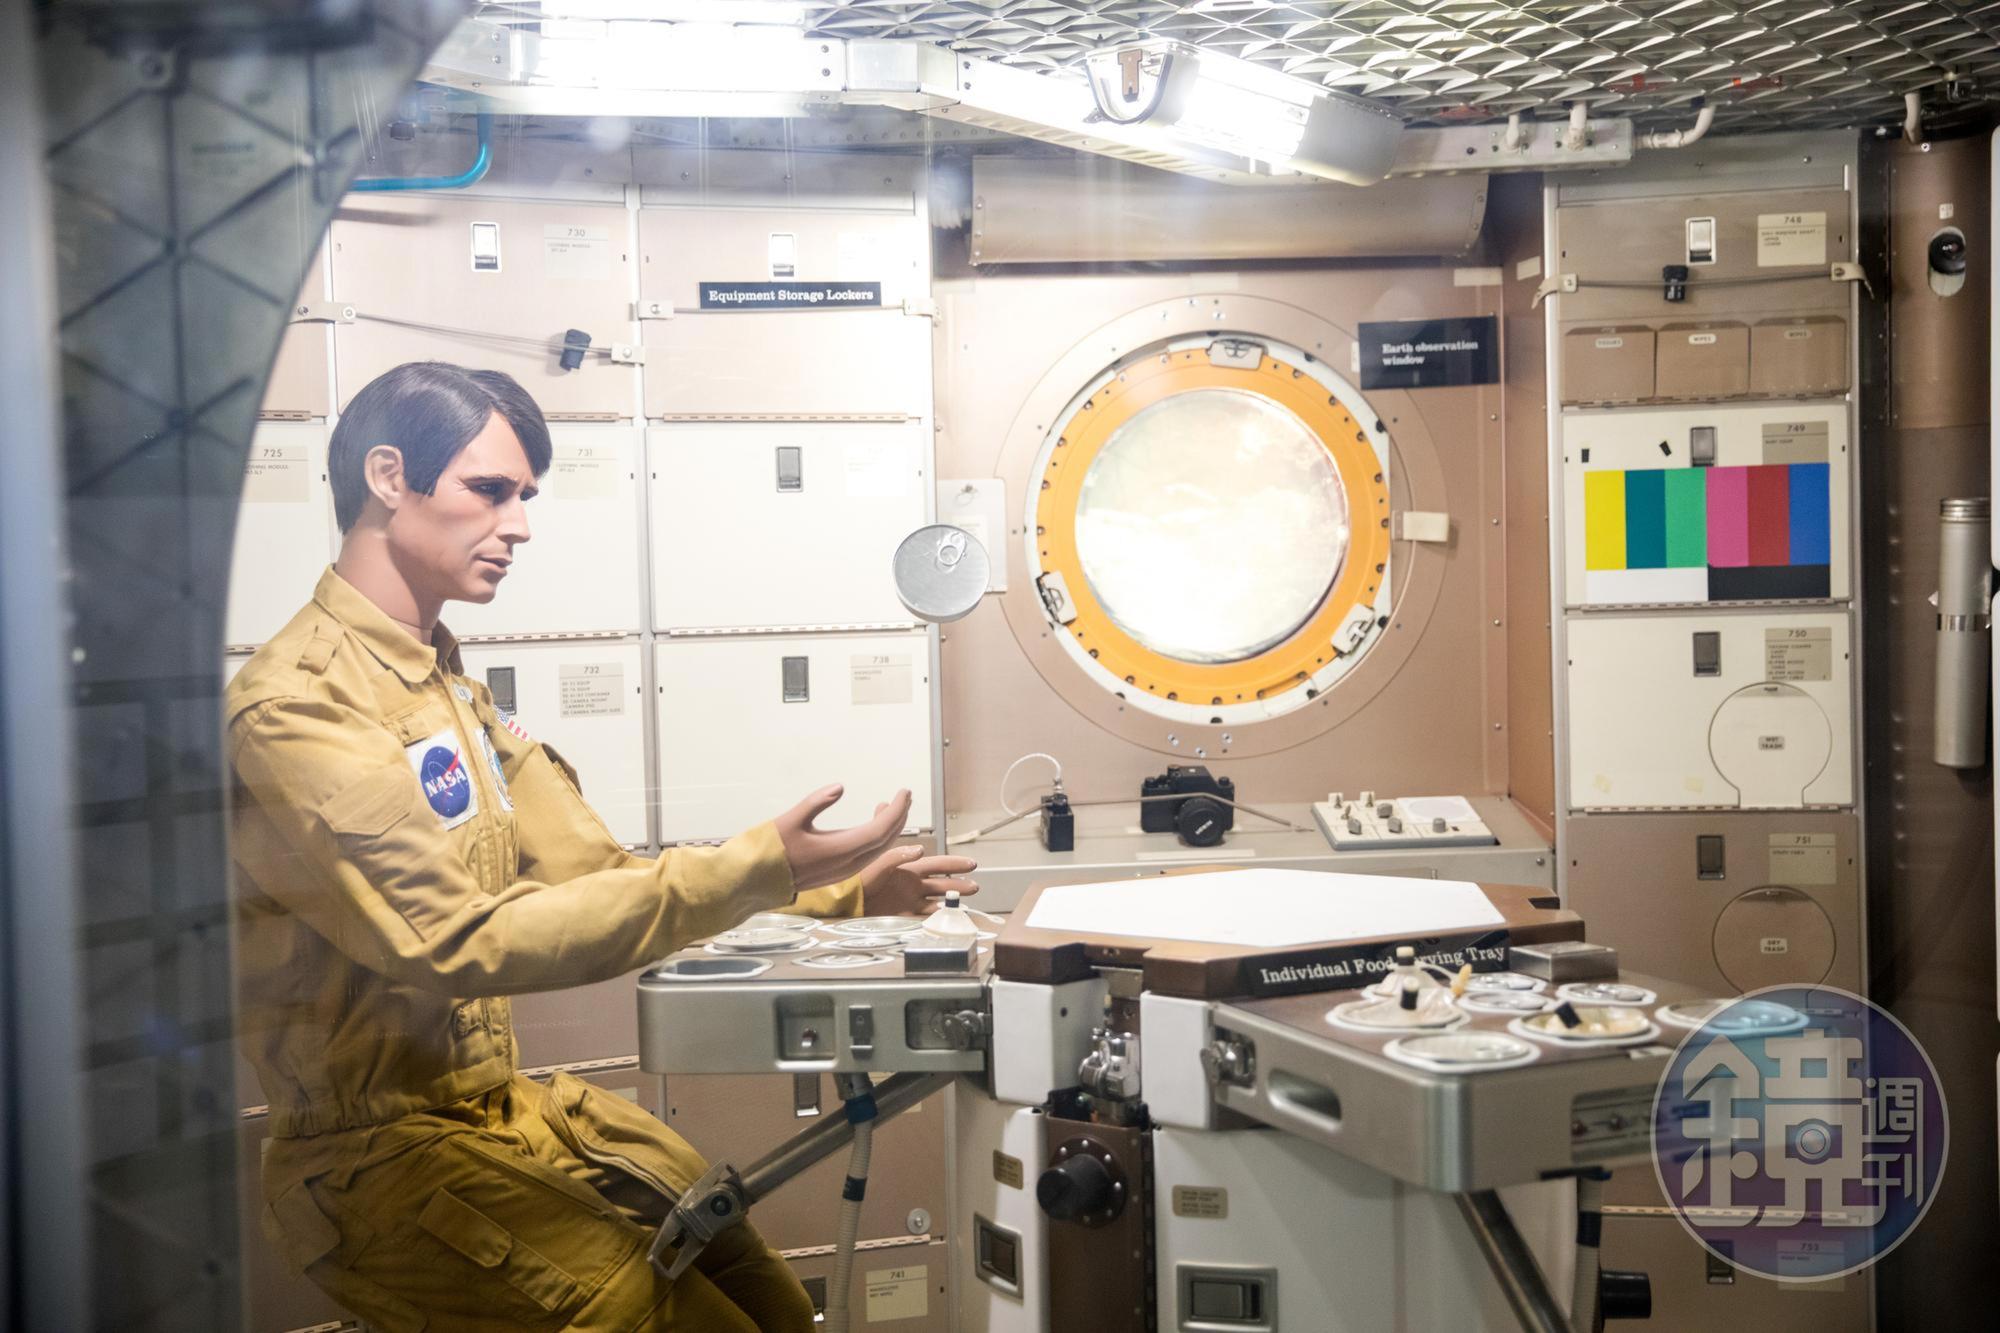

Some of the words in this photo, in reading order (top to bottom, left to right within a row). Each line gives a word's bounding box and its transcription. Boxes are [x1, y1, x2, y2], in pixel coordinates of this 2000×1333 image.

[567, 228, 586, 237] 730
[709, 290, 776, 303] Equipment
[778, 290, 825, 302] Storage
[827, 289, 874, 301] Lockers
[1382, 342, 1414, 354] Earth
[1415, 340, 1479, 352] observation
[1382, 355, 1425, 366] window
[263, 449, 283, 458] 725
[577, 448, 593, 457] 731
[1788, 629, 1807, 638] 750
[583, 666, 600, 674] 732
[425, 767, 467, 798] NASA
[1795, 836, 1811, 844] 751
[1260, 961, 1351, 984] Individual
[1353, 956, 1396, 973] Food
[1414, 951, 1465, 967] rving
[1466, 946, 1505, 961] Tray
[890, 1270, 905, 1279] 741
